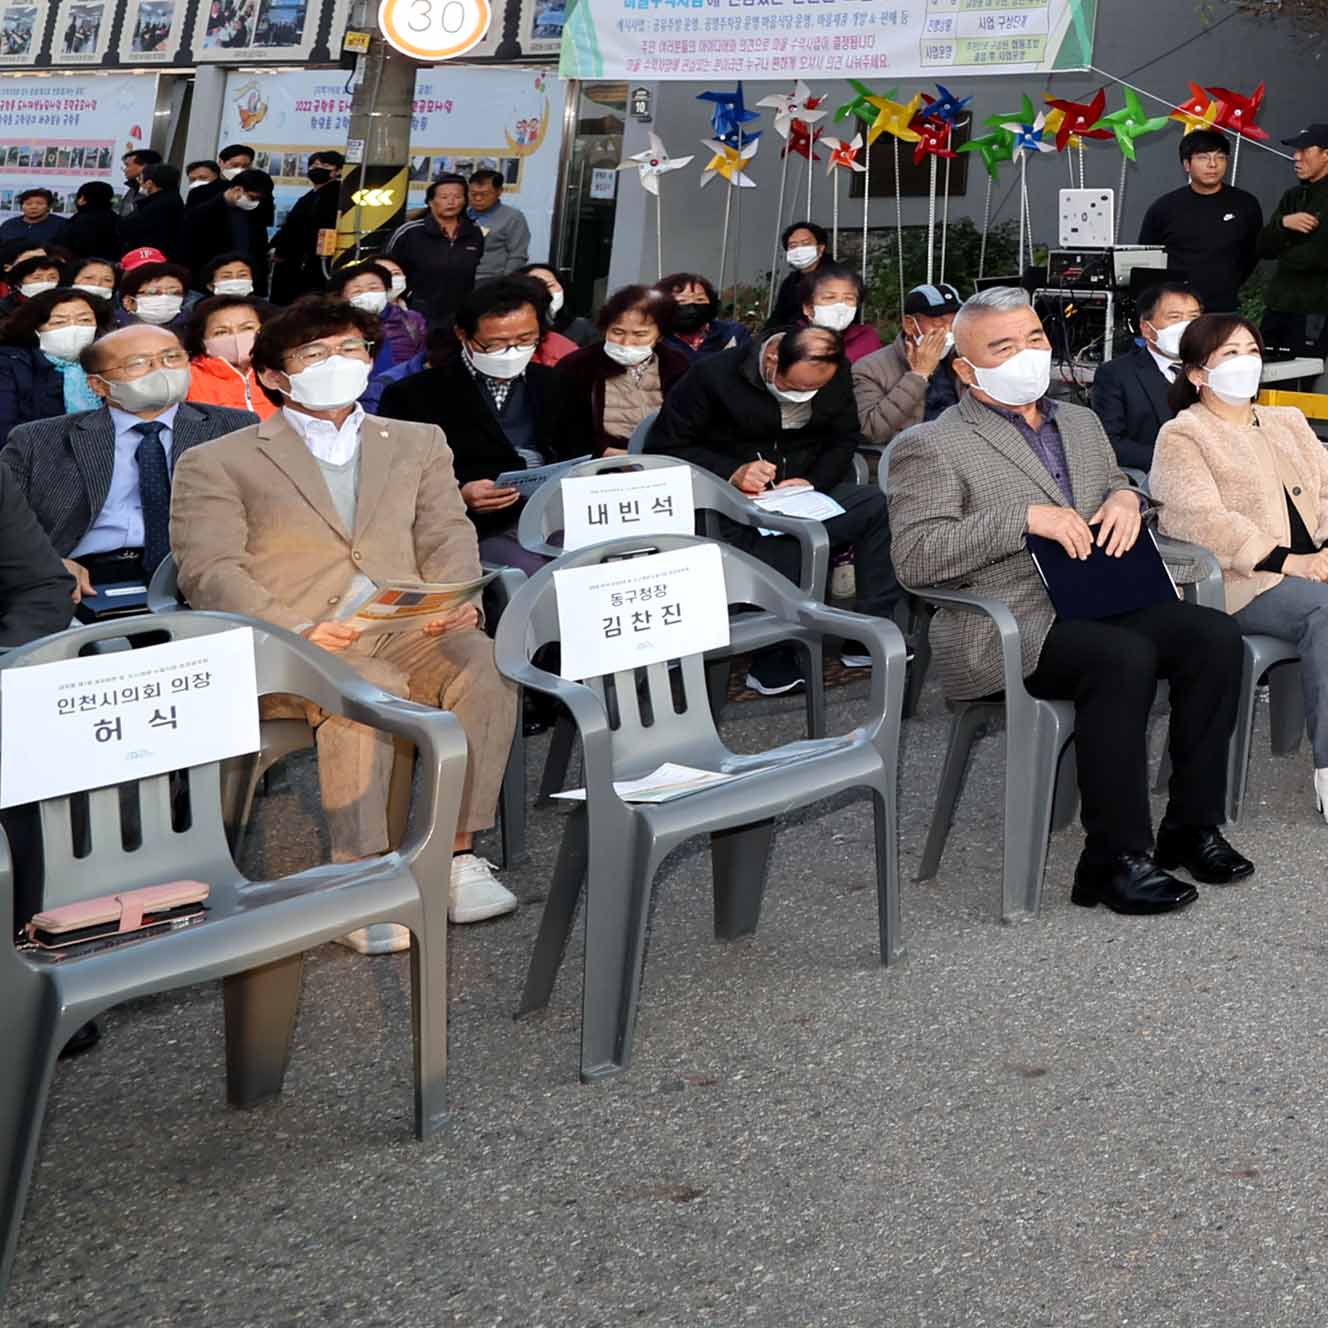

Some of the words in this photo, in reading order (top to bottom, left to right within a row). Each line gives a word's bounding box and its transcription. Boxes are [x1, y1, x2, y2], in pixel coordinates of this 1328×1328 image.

[635, 101, 646, 113] 10
[610, 583, 668, 607] 동구청장
[56, 681, 162, 716] 인천시의회
[170, 671, 213, 694] 의장
